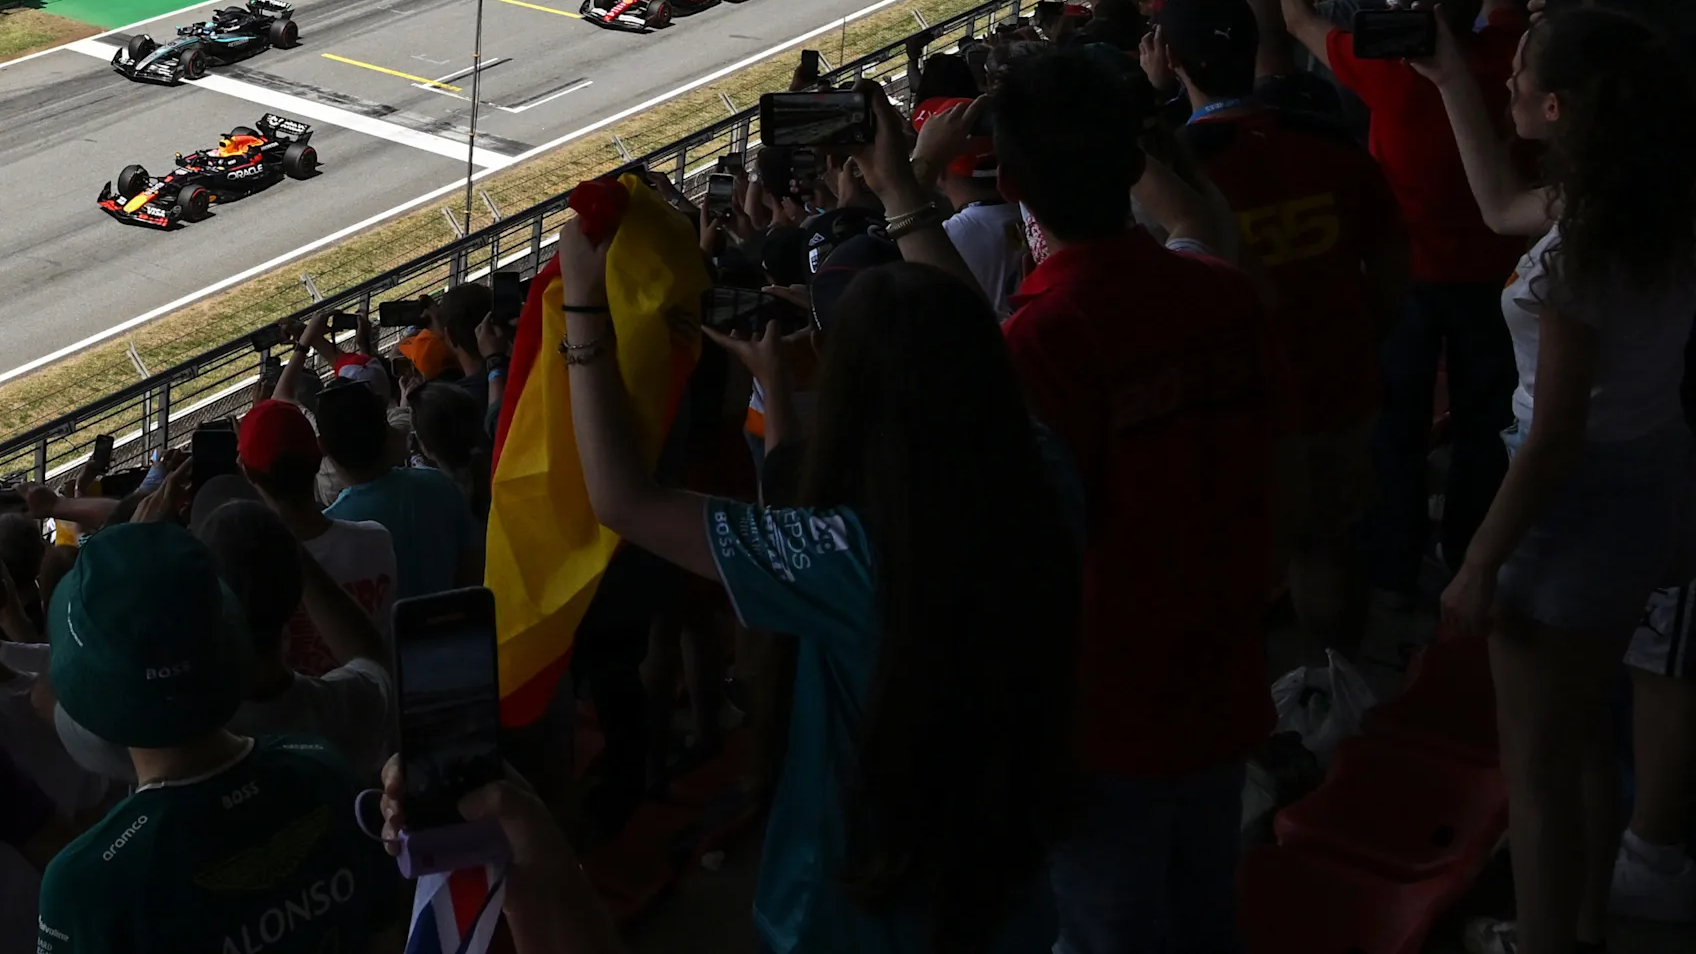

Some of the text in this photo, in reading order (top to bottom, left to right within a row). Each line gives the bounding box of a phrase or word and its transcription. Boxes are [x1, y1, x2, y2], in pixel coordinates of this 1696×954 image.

[227, 165, 264, 181] ORACLE
[714, 511, 735, 558] BOSS
[146, 660, 192, 681] BOSS
[221, 781, 260, 810] BOSS
[103, 815, 148, 862] aramco
[223, 867, 355, 954] ALONSO
